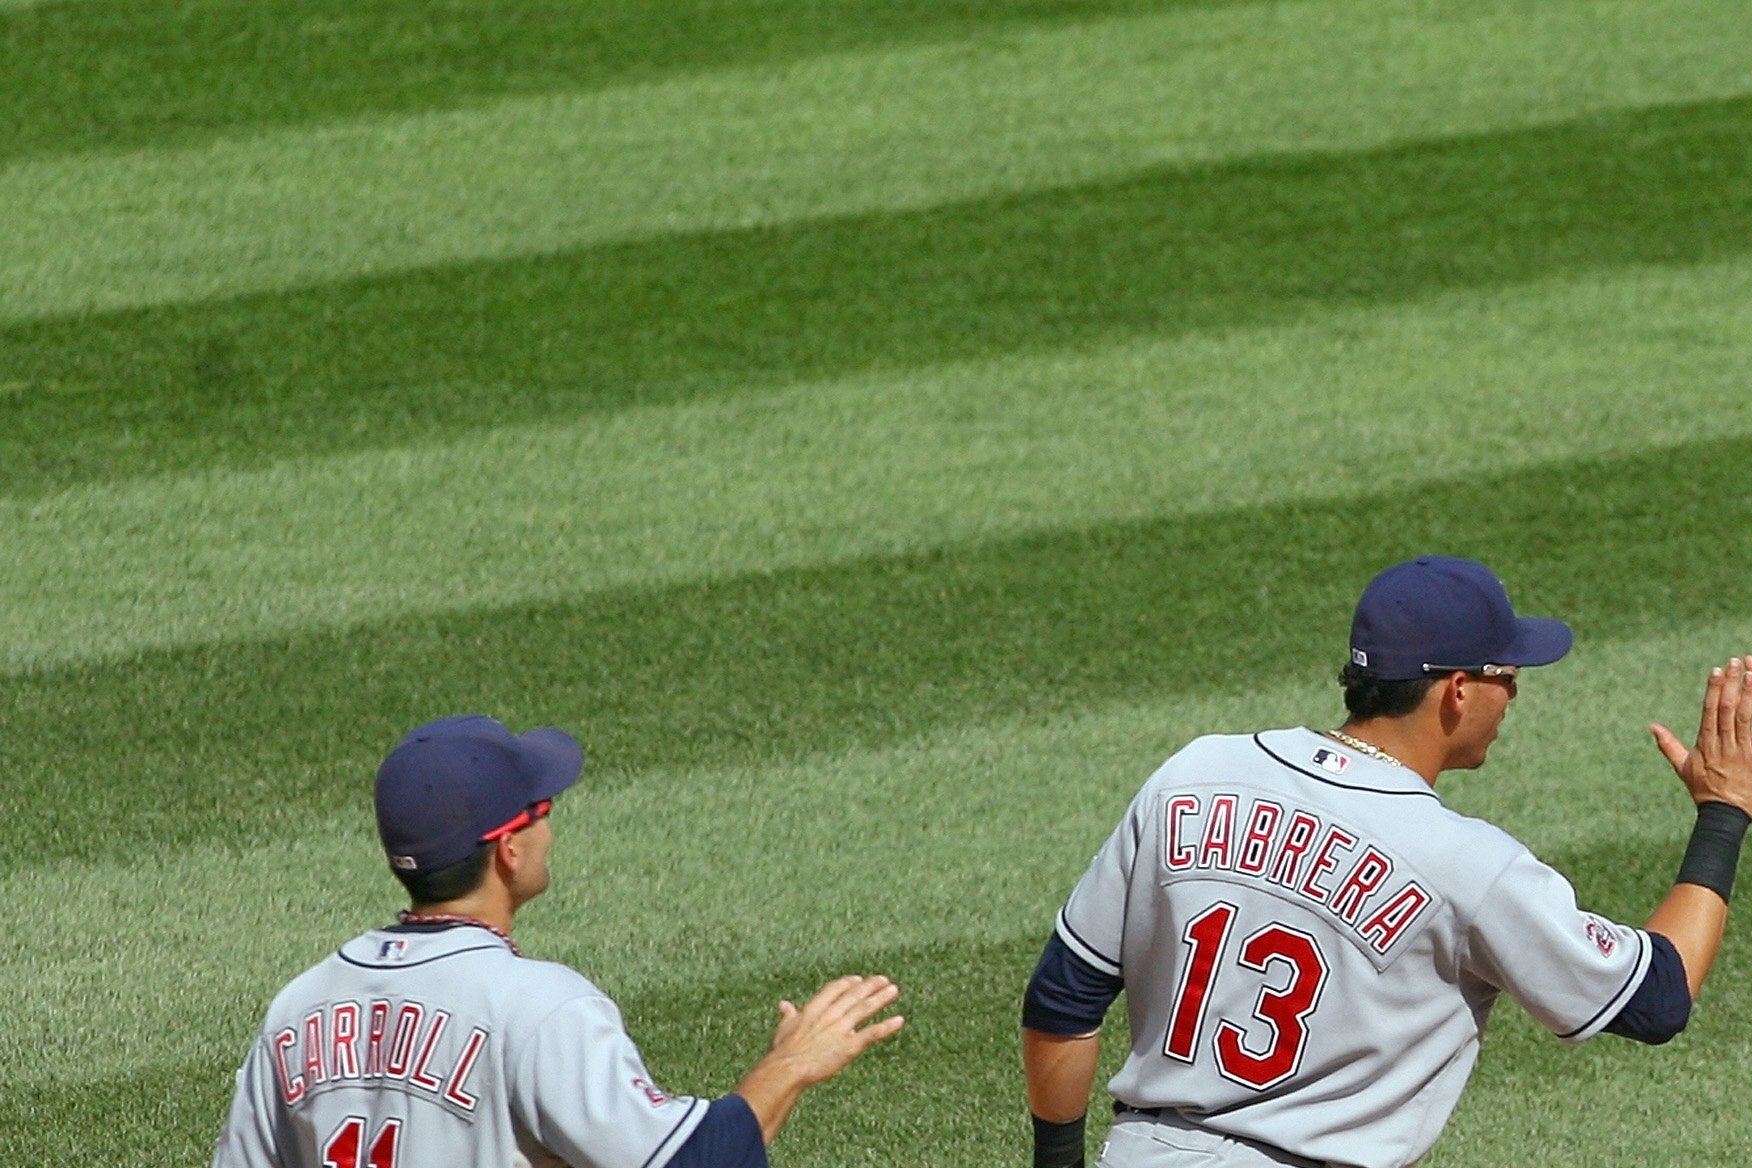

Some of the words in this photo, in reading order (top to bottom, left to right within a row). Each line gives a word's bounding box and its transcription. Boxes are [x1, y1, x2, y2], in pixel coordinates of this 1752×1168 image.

[1164, 793, 1433, 956] CABRERA
[274, 998, 492, 1109] CARROLL
[1162, 900, 1331, 1093] 13
